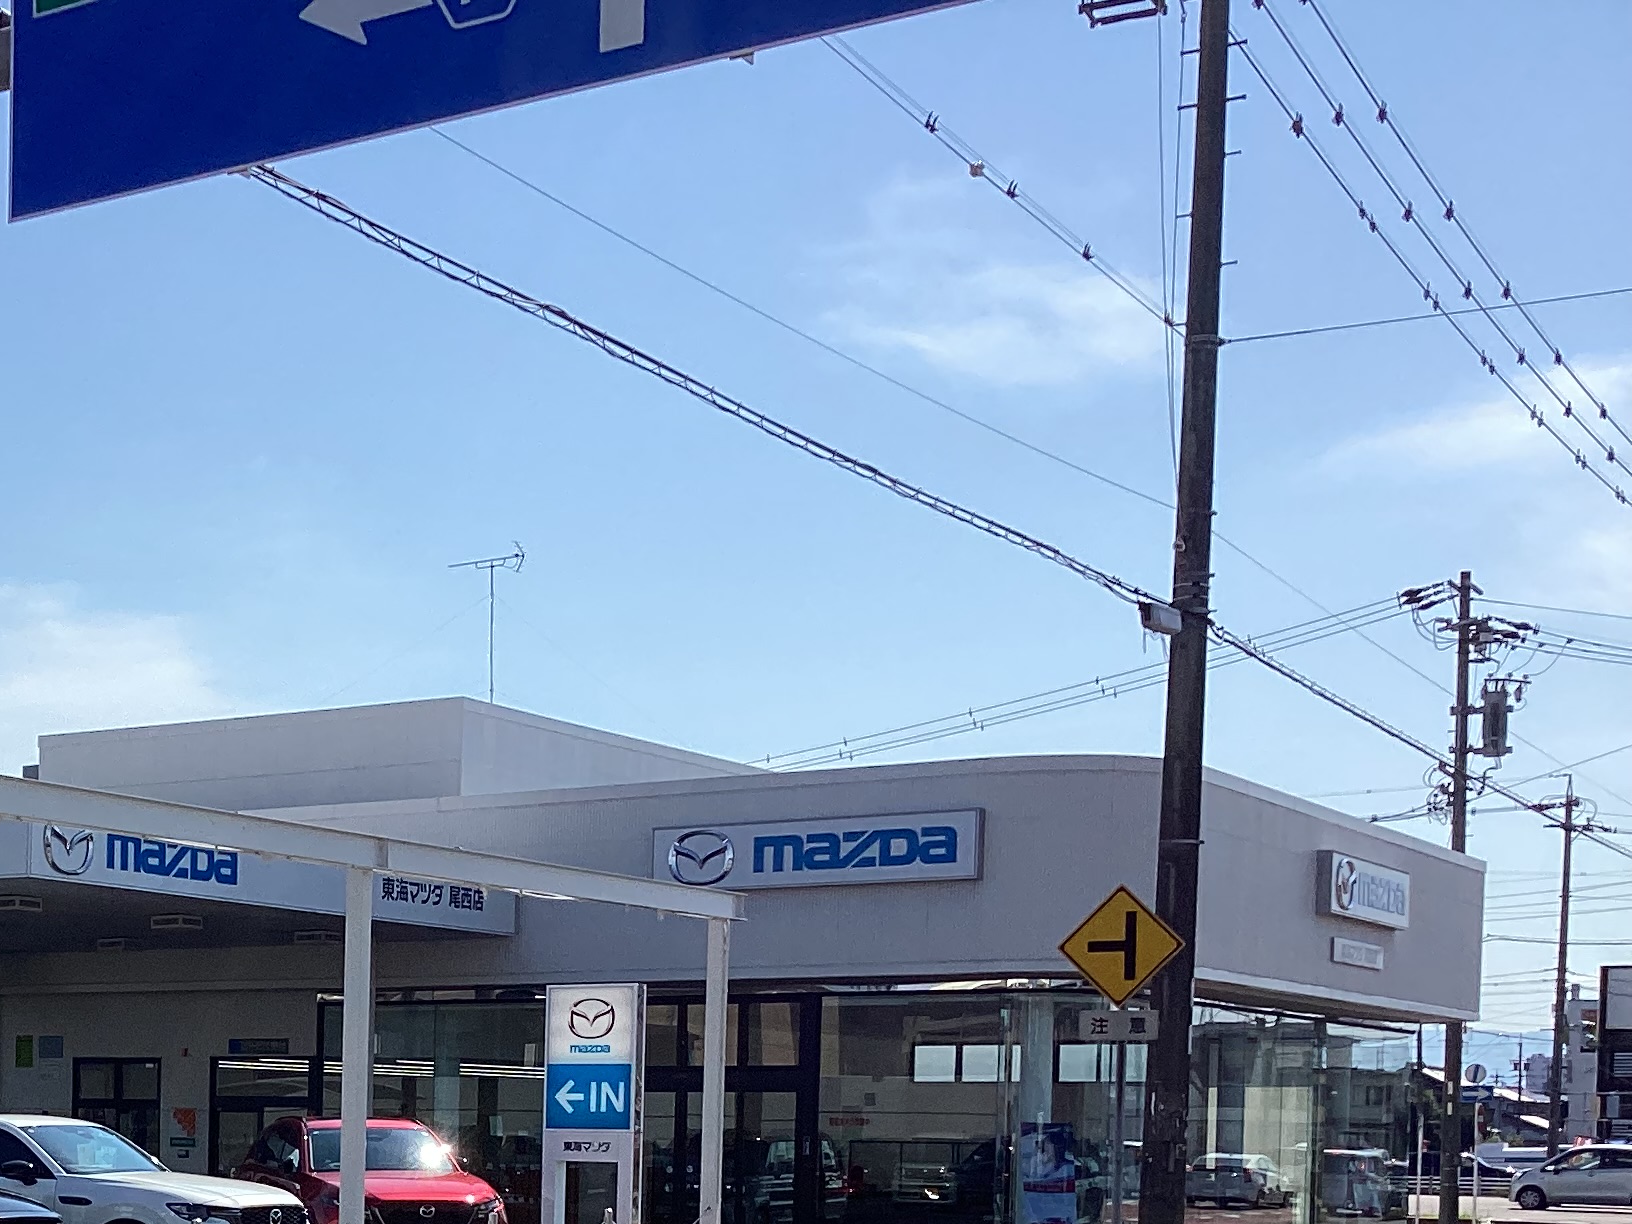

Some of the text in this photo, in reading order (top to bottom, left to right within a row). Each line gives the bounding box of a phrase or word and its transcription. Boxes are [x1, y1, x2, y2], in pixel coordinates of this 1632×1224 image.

[382, 877, 485, 911] 東海マツダ 尾西店
[589, 1081, 625, 1113] IN
